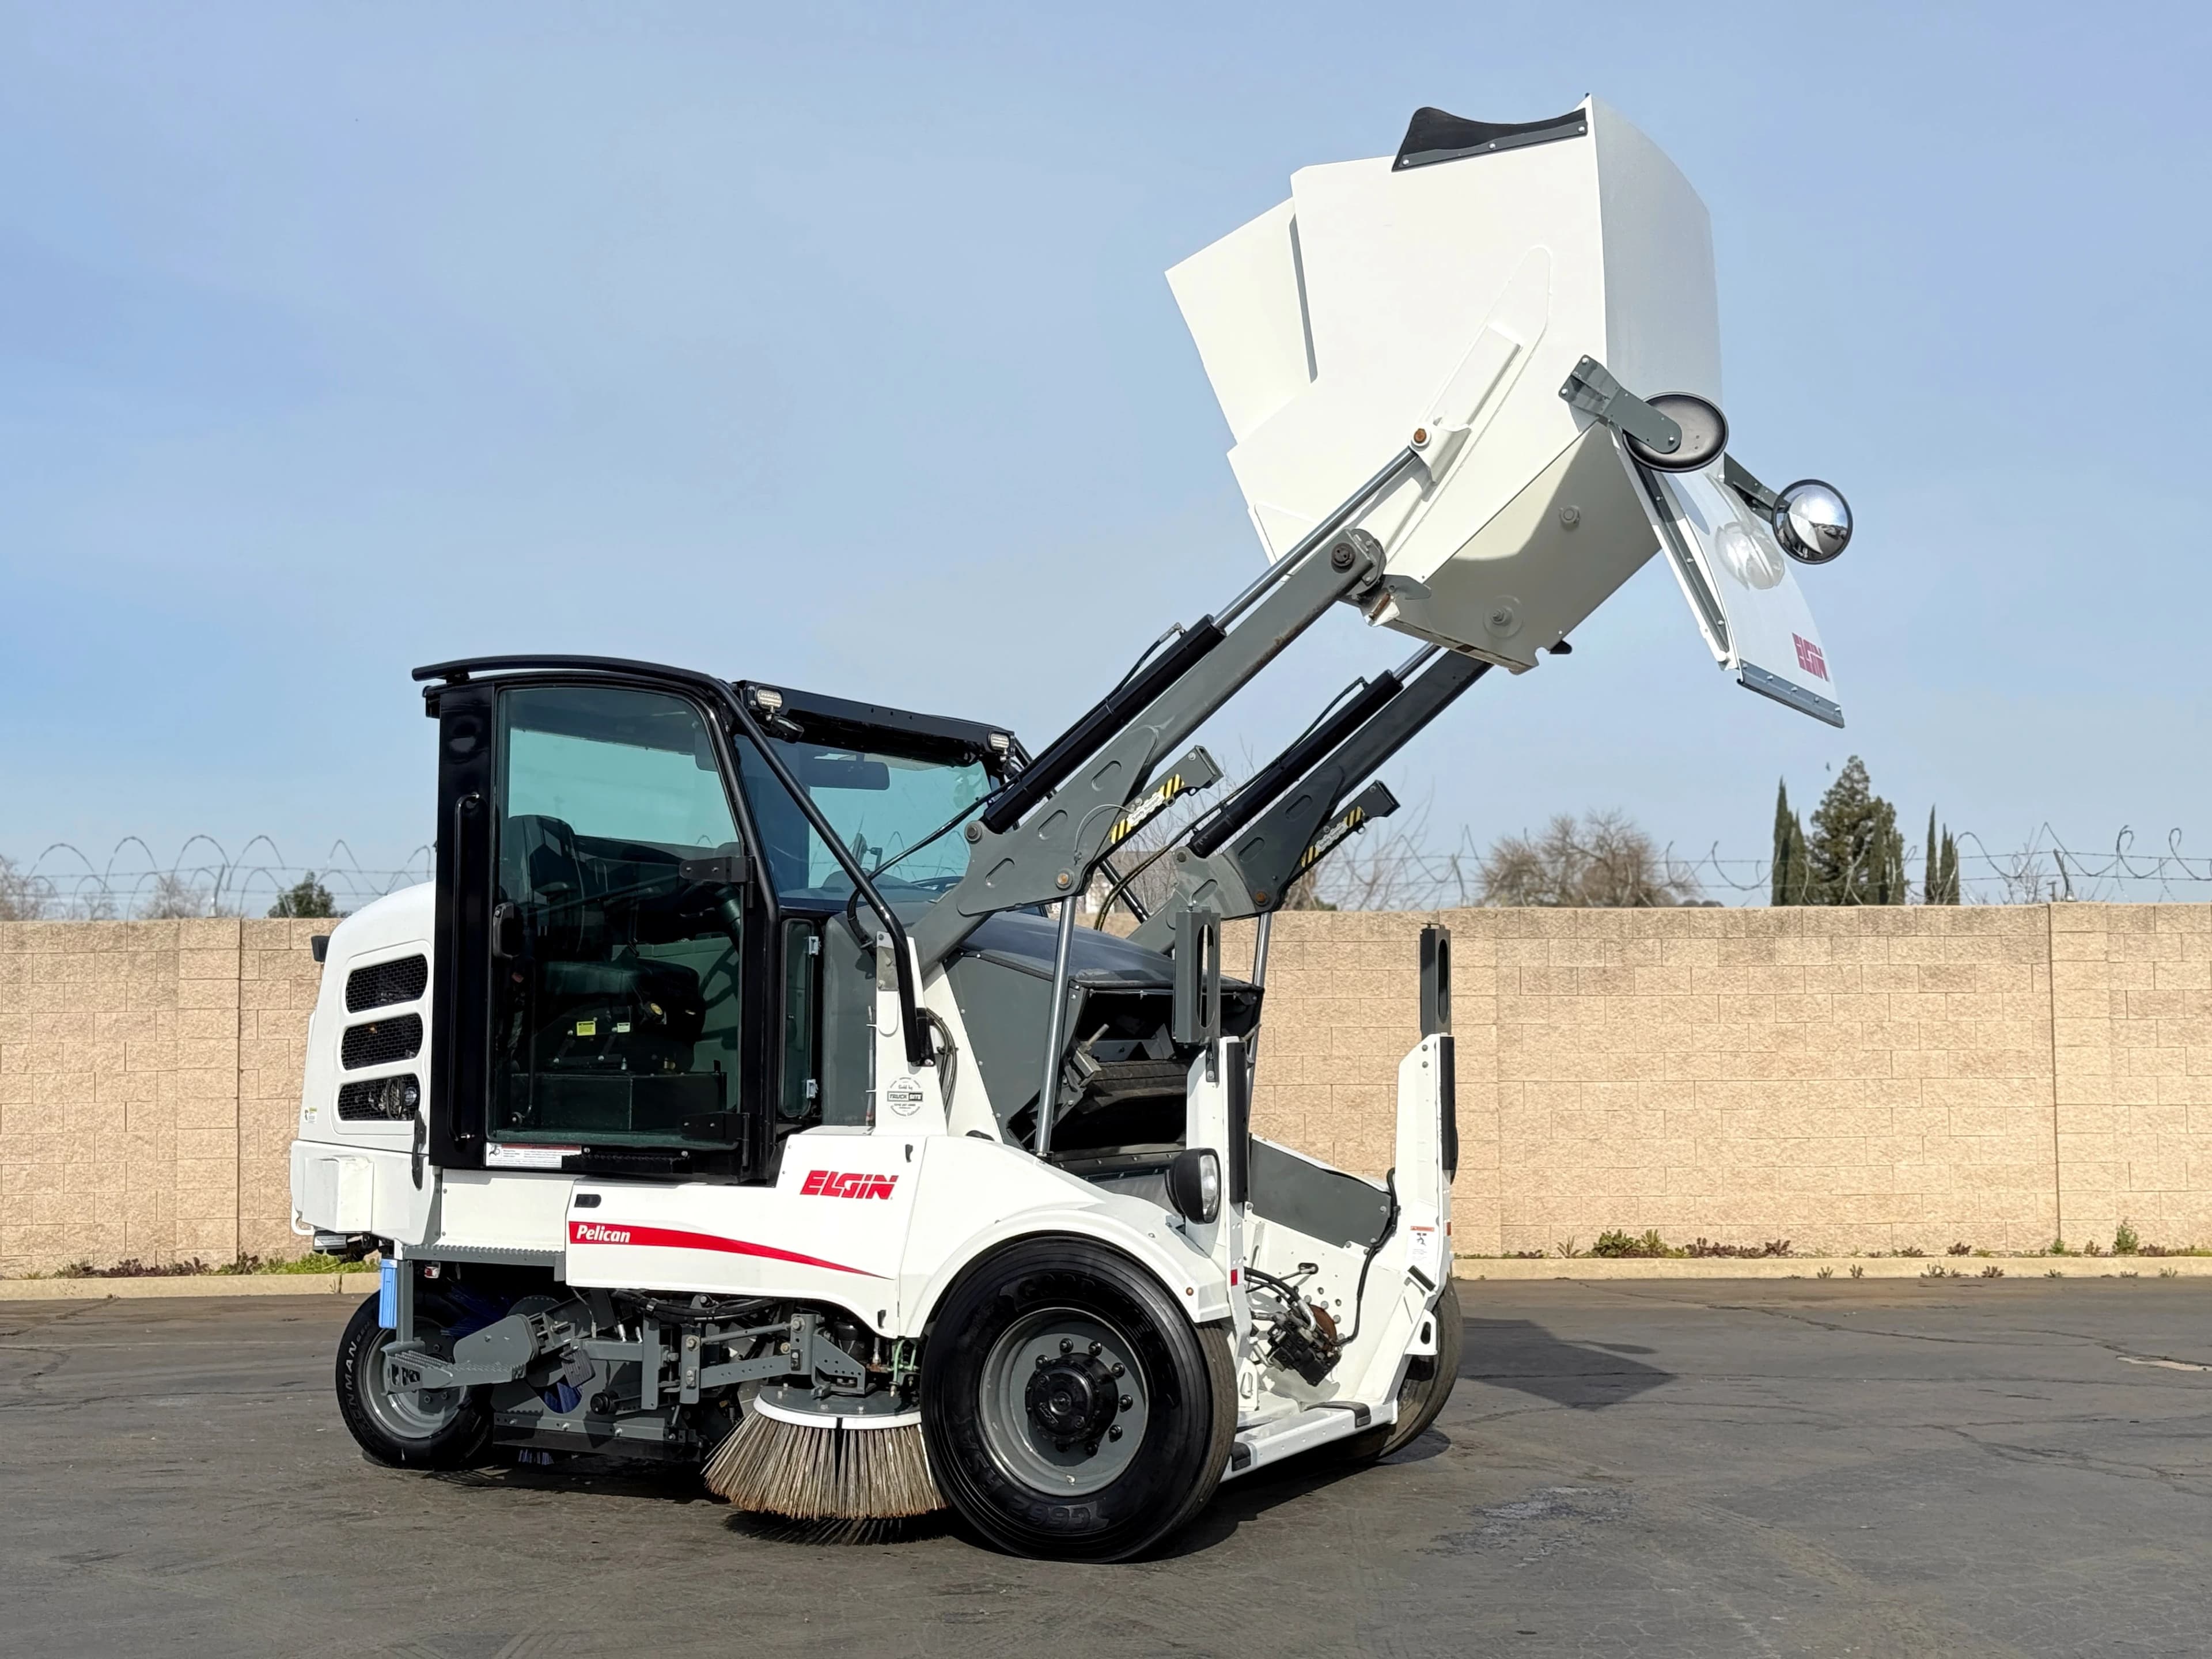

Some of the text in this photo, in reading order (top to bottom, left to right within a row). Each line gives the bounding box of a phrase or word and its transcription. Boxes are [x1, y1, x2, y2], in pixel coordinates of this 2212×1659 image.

[1791, 632, 1827, 681] ELGIN
[800, 1170, 899, 1200] ELGIN
[576, 1225, 631, 1243] Pelican
